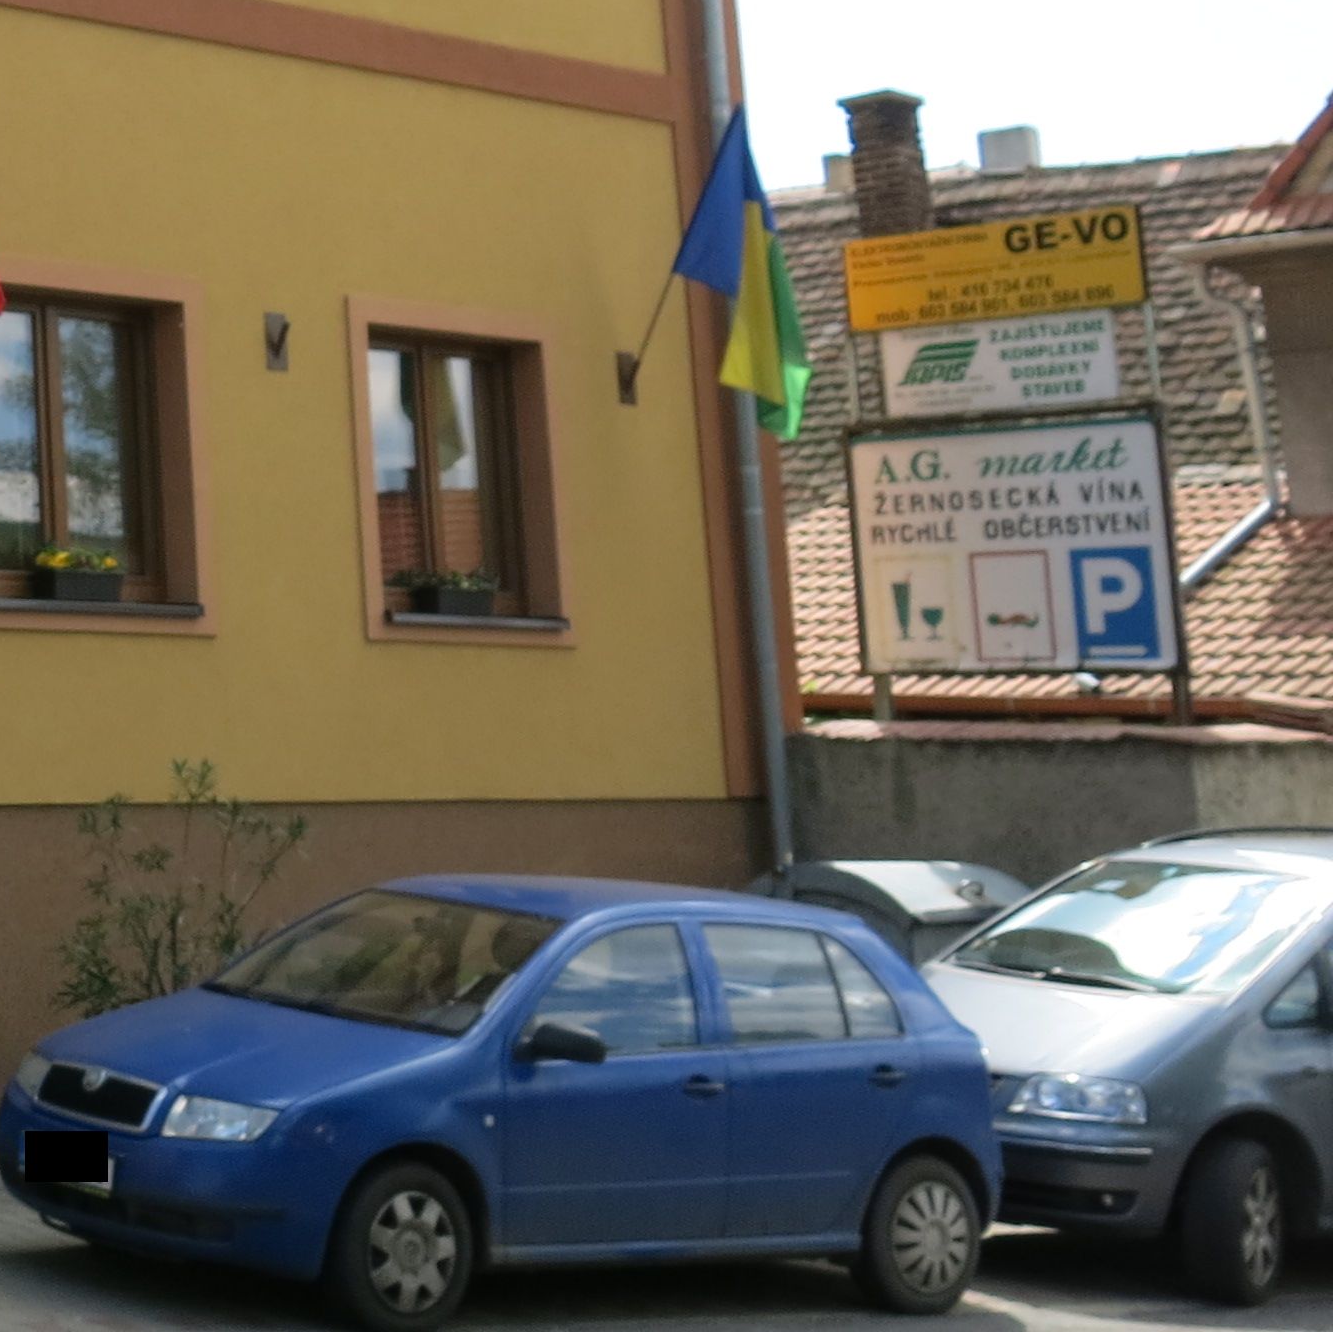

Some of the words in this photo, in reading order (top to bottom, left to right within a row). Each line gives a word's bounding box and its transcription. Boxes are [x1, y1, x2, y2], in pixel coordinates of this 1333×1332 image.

[1004, 213, 1129, 253] GE-VO
[1023, 379, 1087, 397] STAVEB
[874, 449, 951, 485] A.G.
[979, 436, 1129, 478] market
[874, 480, 1061, 516] ŽERNOSECKÁ
[1079, 476, 1145, 504] VÍNA
[871, 517, 957, 546] RYCHLÉ
[984, 505, 1151, 541] OBČERSTVENÍ
[1080, 557, 1143, 636] P
